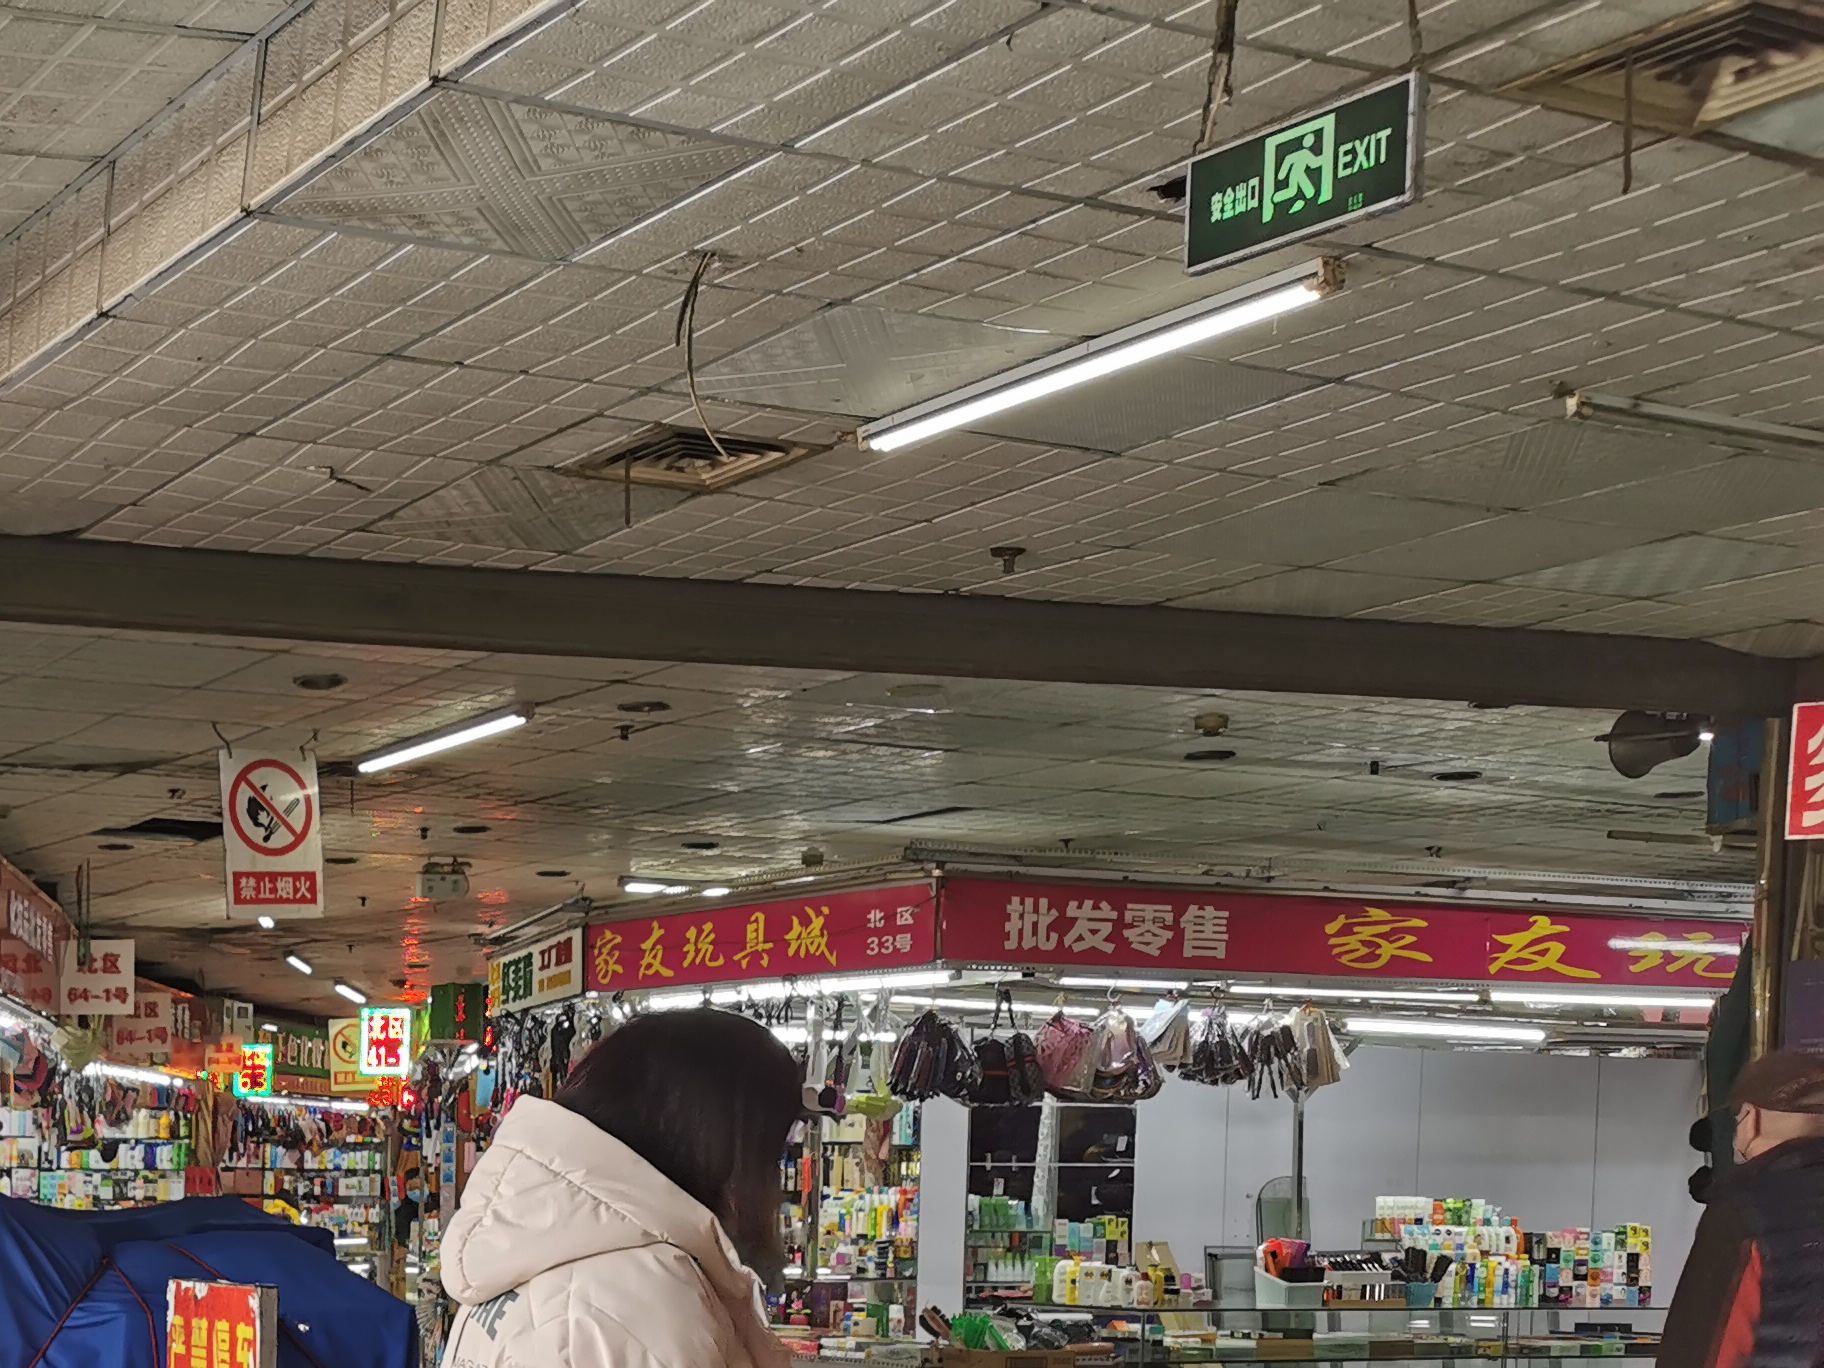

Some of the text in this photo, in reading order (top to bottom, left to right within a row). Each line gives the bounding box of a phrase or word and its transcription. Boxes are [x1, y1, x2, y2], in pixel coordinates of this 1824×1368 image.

[1337, 127, 1392, 179] EXIT
[1210, 176, 1260, 222] 安全出口
[239, 875, 312, 900] 禁止烟火
[866, 906, 916, 929] 北区
[1004, 896, 1230, 959] 批发零售
[593, 906, 837, 984] 家友玩具城
[866, 933, 912, 956] 33号
[239, 1069, 267, 1093] 63
